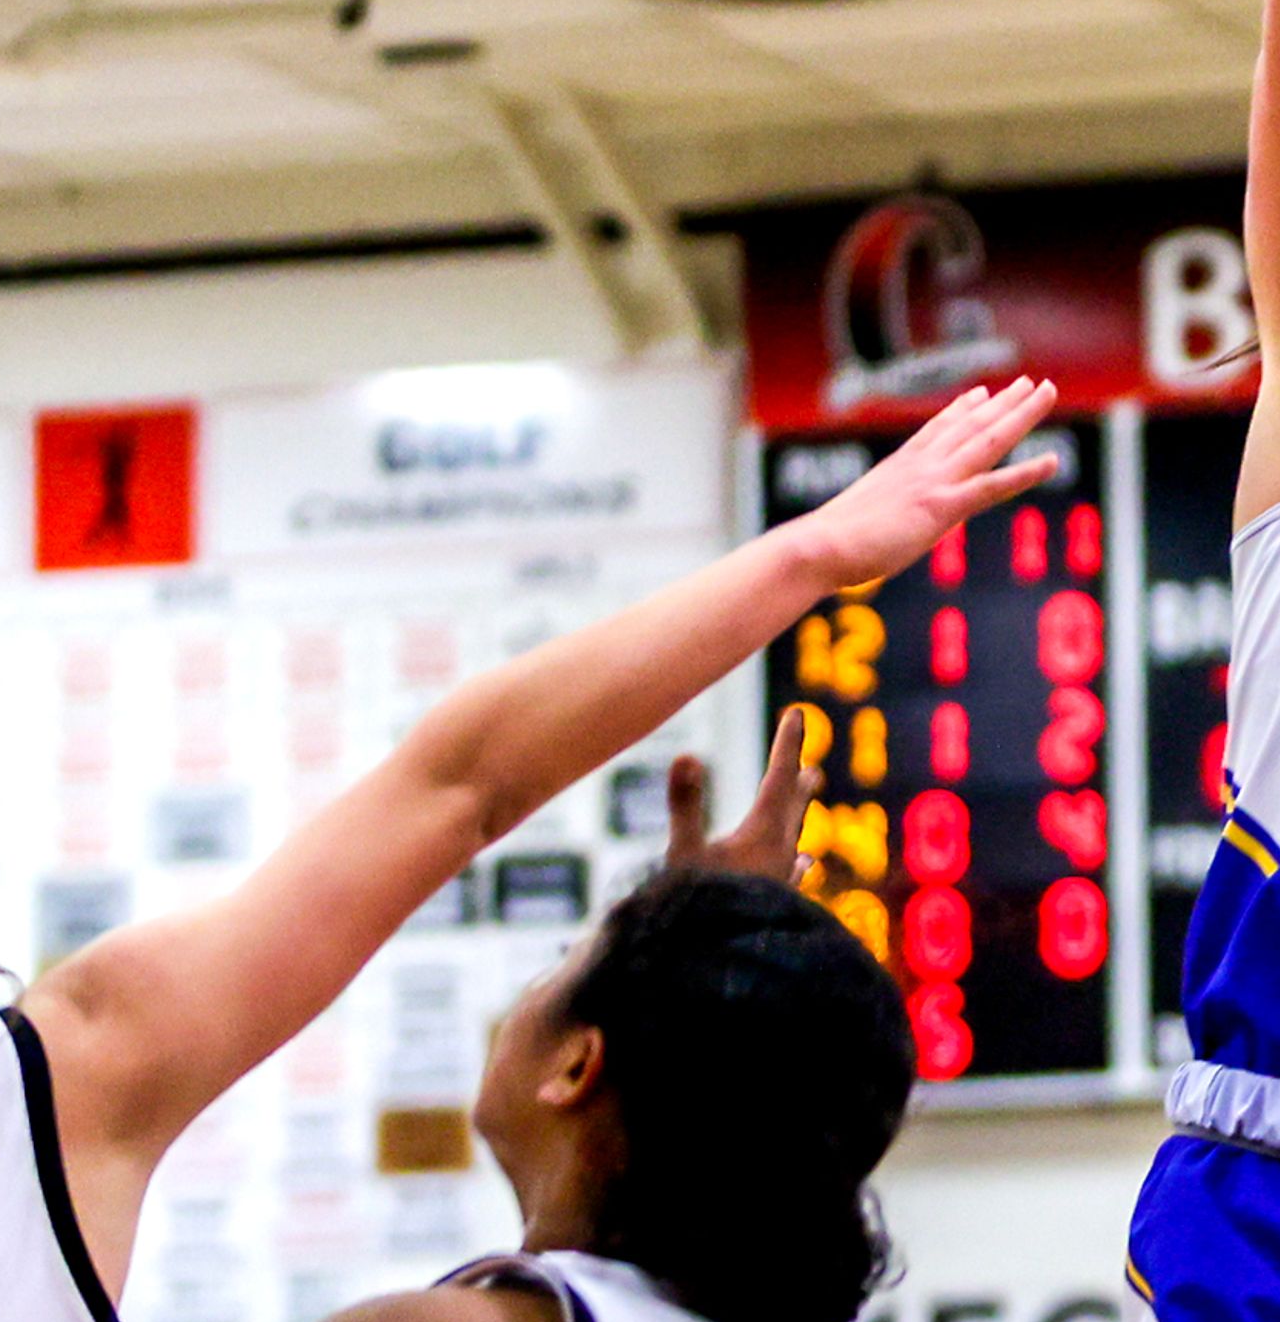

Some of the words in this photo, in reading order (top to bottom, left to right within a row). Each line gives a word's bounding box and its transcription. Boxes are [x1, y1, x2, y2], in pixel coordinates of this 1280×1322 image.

[1008, 501, 1104, 583] 11
[796, 604, 888, 700] 12
[928, 605, 970, 686] 1
[1035, 590, 1106, 686] 0
[928, 700, 970, 783] 1
[1035, 684, 1106, 786] 2
[902, 788, 974, 886] 0
[1036, 786, 1108, 872] 4
[902, 884, 974, 984] 0
[1036, 875, 1110, 982] 0
